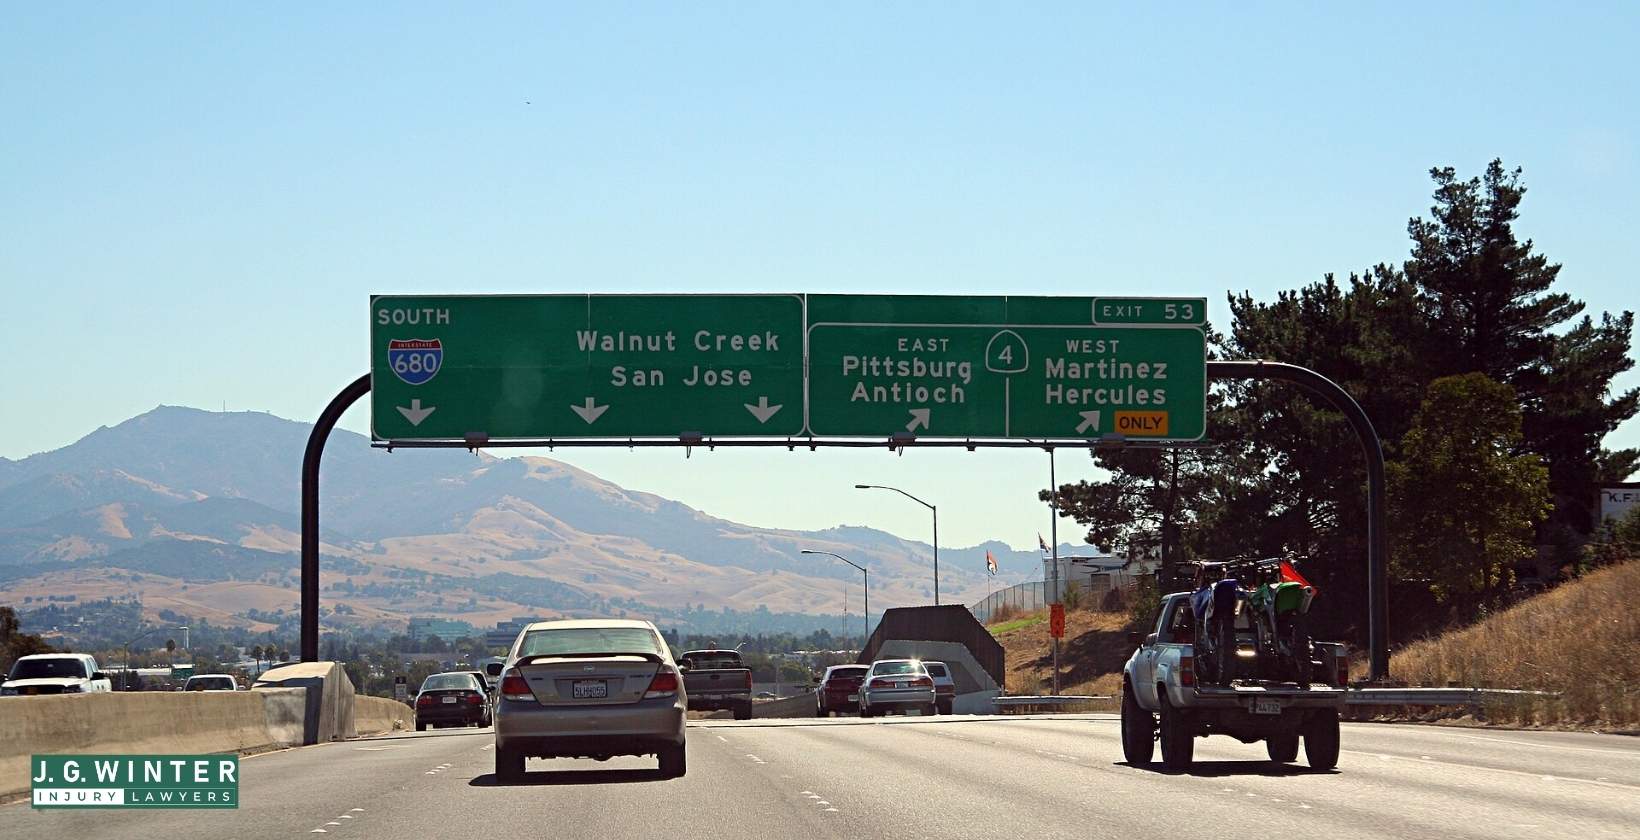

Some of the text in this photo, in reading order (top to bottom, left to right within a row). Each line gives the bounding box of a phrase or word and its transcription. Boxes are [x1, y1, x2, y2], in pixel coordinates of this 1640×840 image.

[378, 309, 450, 325] SOUTH
[1103, 304, 1194, 319] EXIT 53
[577, 330, 779, 352] Walnut Creek
[898, 338, 949, 352] EAST
[1066, 340, 1120, 353] WEST
[395, 353, 437, 374] 680
[998, 345, 1013, 365] 4
[611, 365, 753, 387] San Jose
[843, 356, 972, 384] Pittsburg
[1045, 358, 1168, 379] Martinez
[850, 382, 966, 404] Antioch
[1045, 384, 1167, 405] Hercules
[1119, 416, 1164, 430] ONLY
